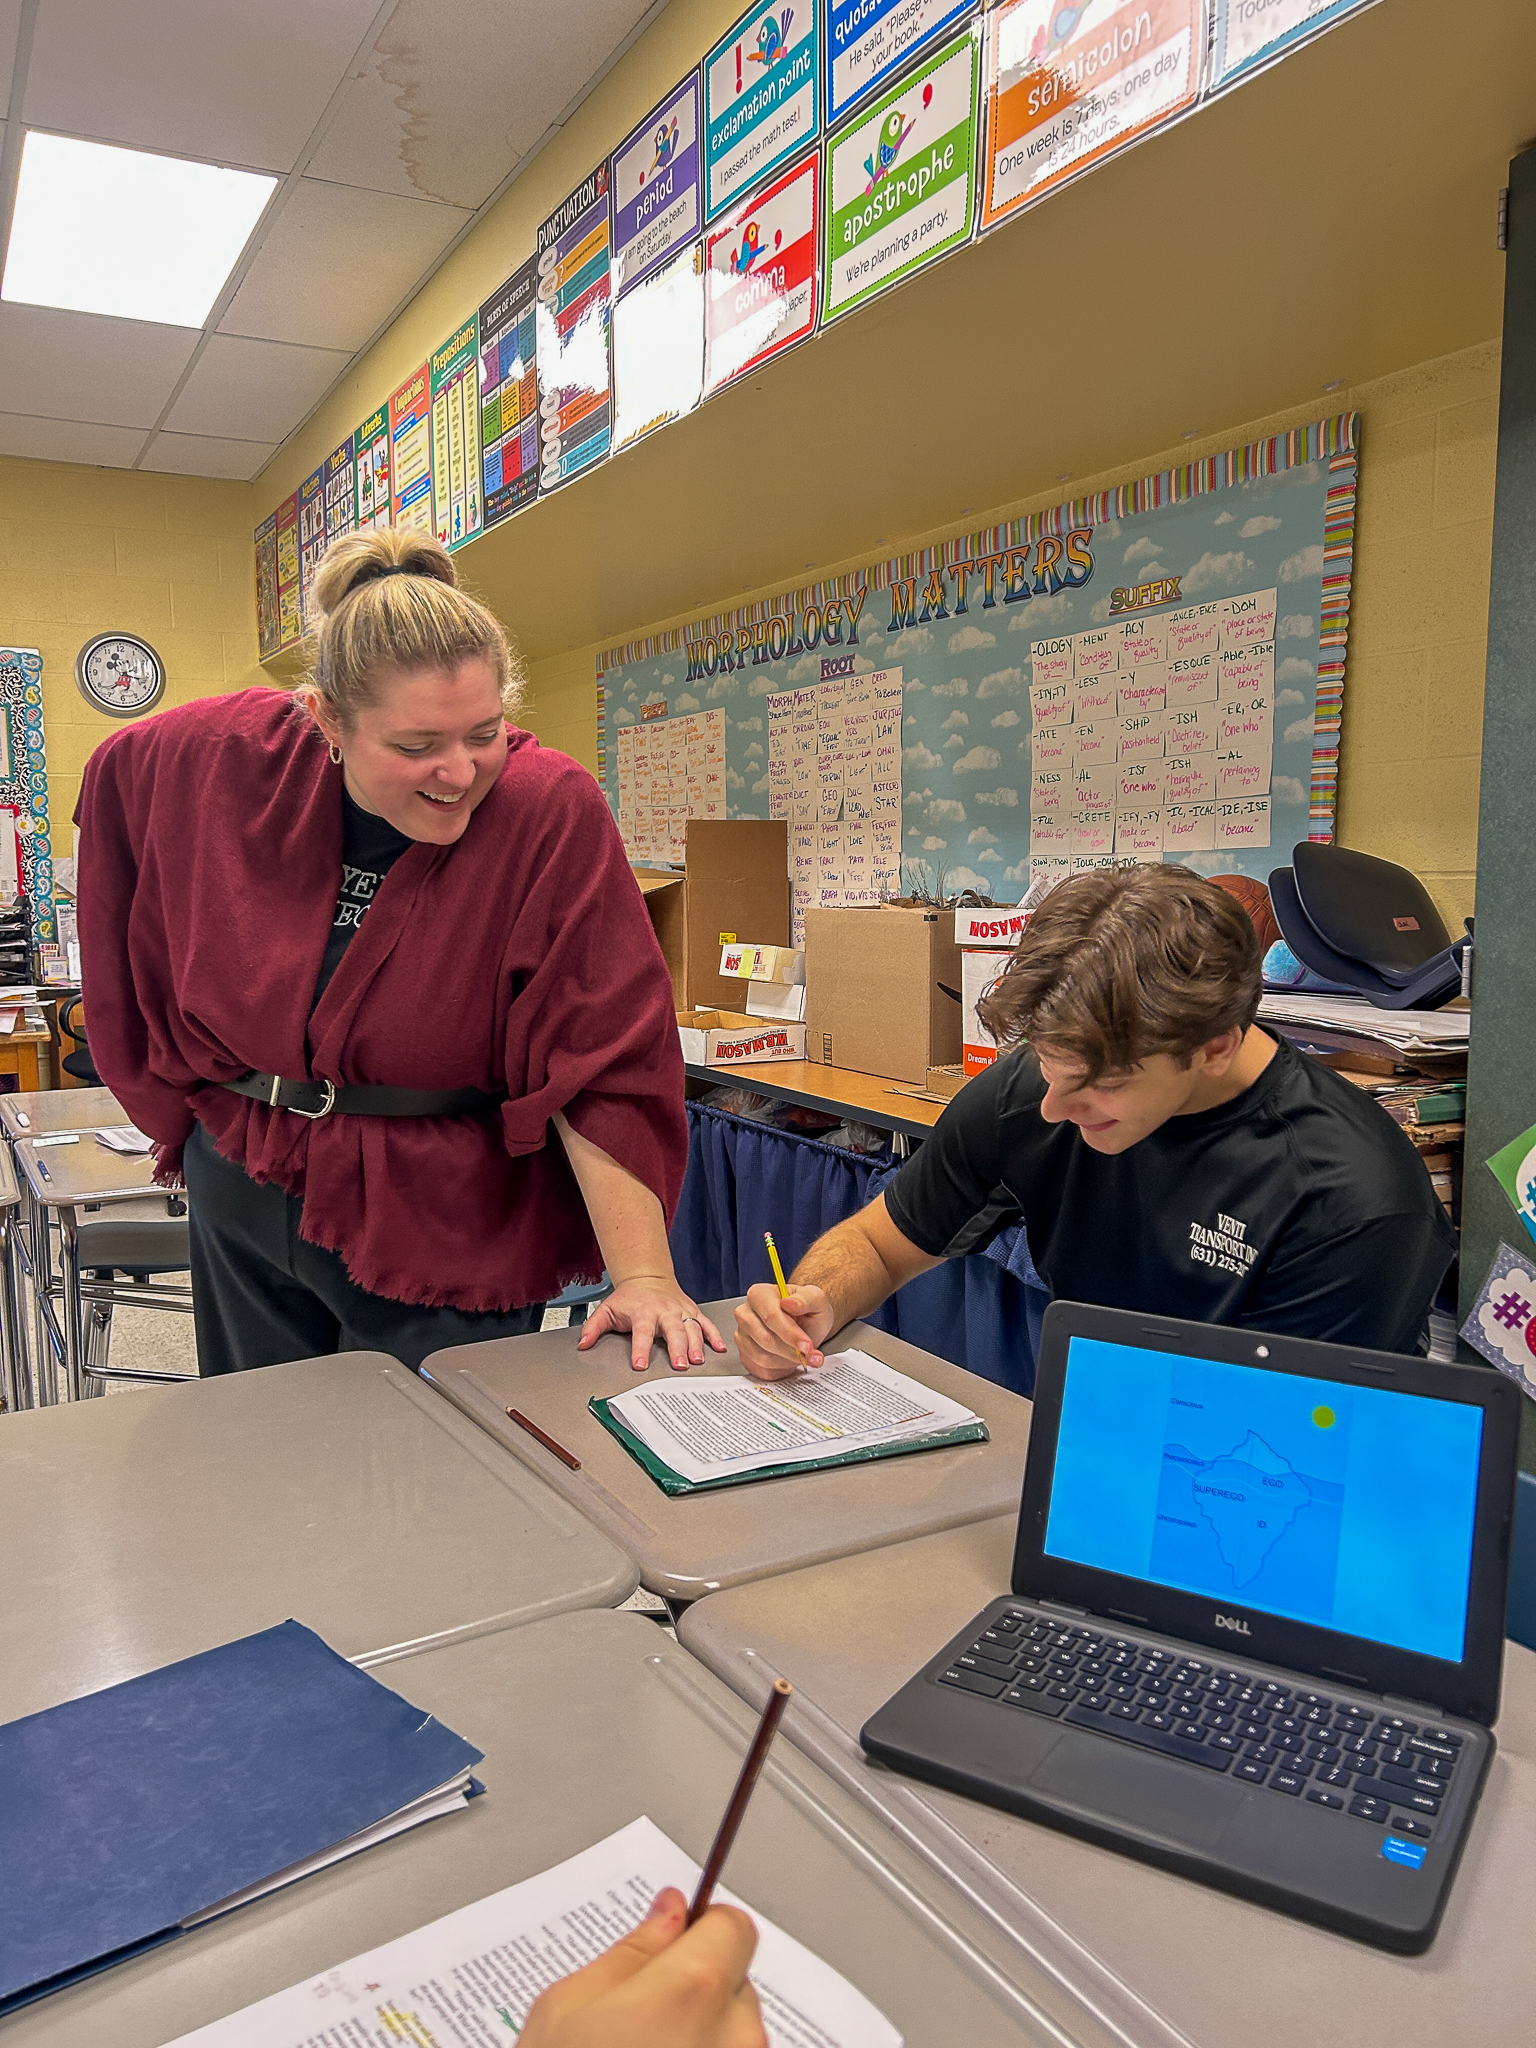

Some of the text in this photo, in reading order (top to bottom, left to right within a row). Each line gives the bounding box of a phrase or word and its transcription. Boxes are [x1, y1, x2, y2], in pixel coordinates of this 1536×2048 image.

[850, 50, 862, 69] He
[864, 28, 885, 56] said,
[872, 41, 893, 73] your
[1027, 10, 1152, 117] semicolon
[712, 48, 811, 150] exclamation point
[999, 151, 1024, 176] One
[1027, 126, 1059, 159] week
[1062, 120, 1073, 136] is
[1076, 107, 1083, 125] 7
[1124, 73, 1150, 97] one
[1155, 48, 1181, 78] day
[724, 155, 748, 185] passed
[749, 145, 761, 162] the
[762, 126, 781, 150] math
[782, 105, 801, 133] test!
[1049, 115, 1120, 168] is 24 hours.
[636, 168, 673, 229] period
[844, 143, 954, 245] apostrophe
[538, 176, 595, 253] PUNCTUATION
[627, 201, 687, 260] am going to the beach
[846, 209, 948, 282] We're planning a party.
[639, 254, 646, 265] on
[735, 265, 785, 314] comma
[486, 278, 530, 328] PARTS OF SPEECH
[433, 323, 475, 376] Prepositions
[394, 376, 425, 415] Conjunctions
[361, 413, 382, 440] Adverbs
[331, 448, 346, 471] Verbs
[887, 527, 1094, 634] MATTERS
[1110, 576, 1182, 611] SUFFIX
[1224, 599, 1256, 614] -DOM
[685, 585, 868, 683] MORPHOLOGY
[1079, 632, 1109, 646] -MENT
[1119, 621, 1144, 637] -ACY
[1033, 637, 1072, 656] -OLOGY
[820, 653, 855, 678] ROOT
[1169, 654, 1211, 672] -ESQUE
[1075, 677, 1098, 688] -LESS
[1121, 717, 1150, 731] -SHIP
[1170, 711, 1198, 724] -ISM
[1033, 729, 1057, 740] -ATE
[1165, 759, 1191, 770] -ISH
[1035, 774, 1061, 784] -NESS
[968, 1053, 992, 1065] Dream it
[1189, 1222, 1246, 1260] TRANSPORT
[1191, 1244, 1216, 1267] (631)
[1171, 1397, 1204, 1410] Conscious
[1193, 1483, 1245, 1502] SUPEREGO
[1262, 1477, 1284, 1489] EGO
[1157, 1513, 1197, 1528] Unconscious
[1256, 1520, 1267, 1529] ID
[1215, 1614, 1252, 1636] DELL
